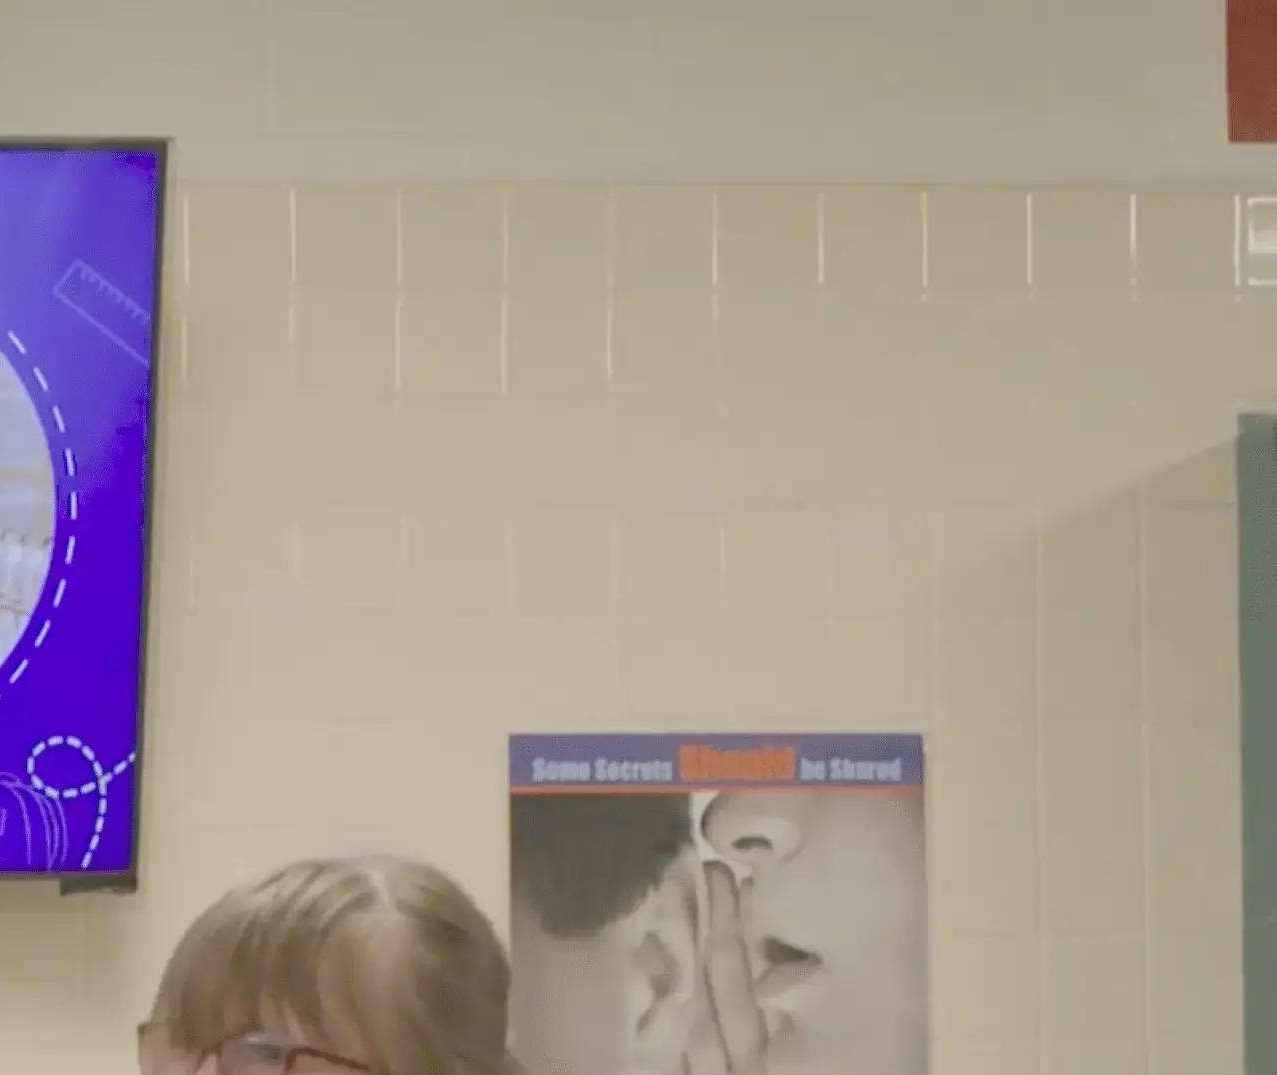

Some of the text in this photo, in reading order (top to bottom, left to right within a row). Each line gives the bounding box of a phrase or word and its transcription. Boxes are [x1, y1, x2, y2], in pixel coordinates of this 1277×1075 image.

[532, 756, 591, 782] Some
[595, 756, 674, 782] Secrets
[800, 757, 825, 781] be
[829, 756, 902, 782] Shared
